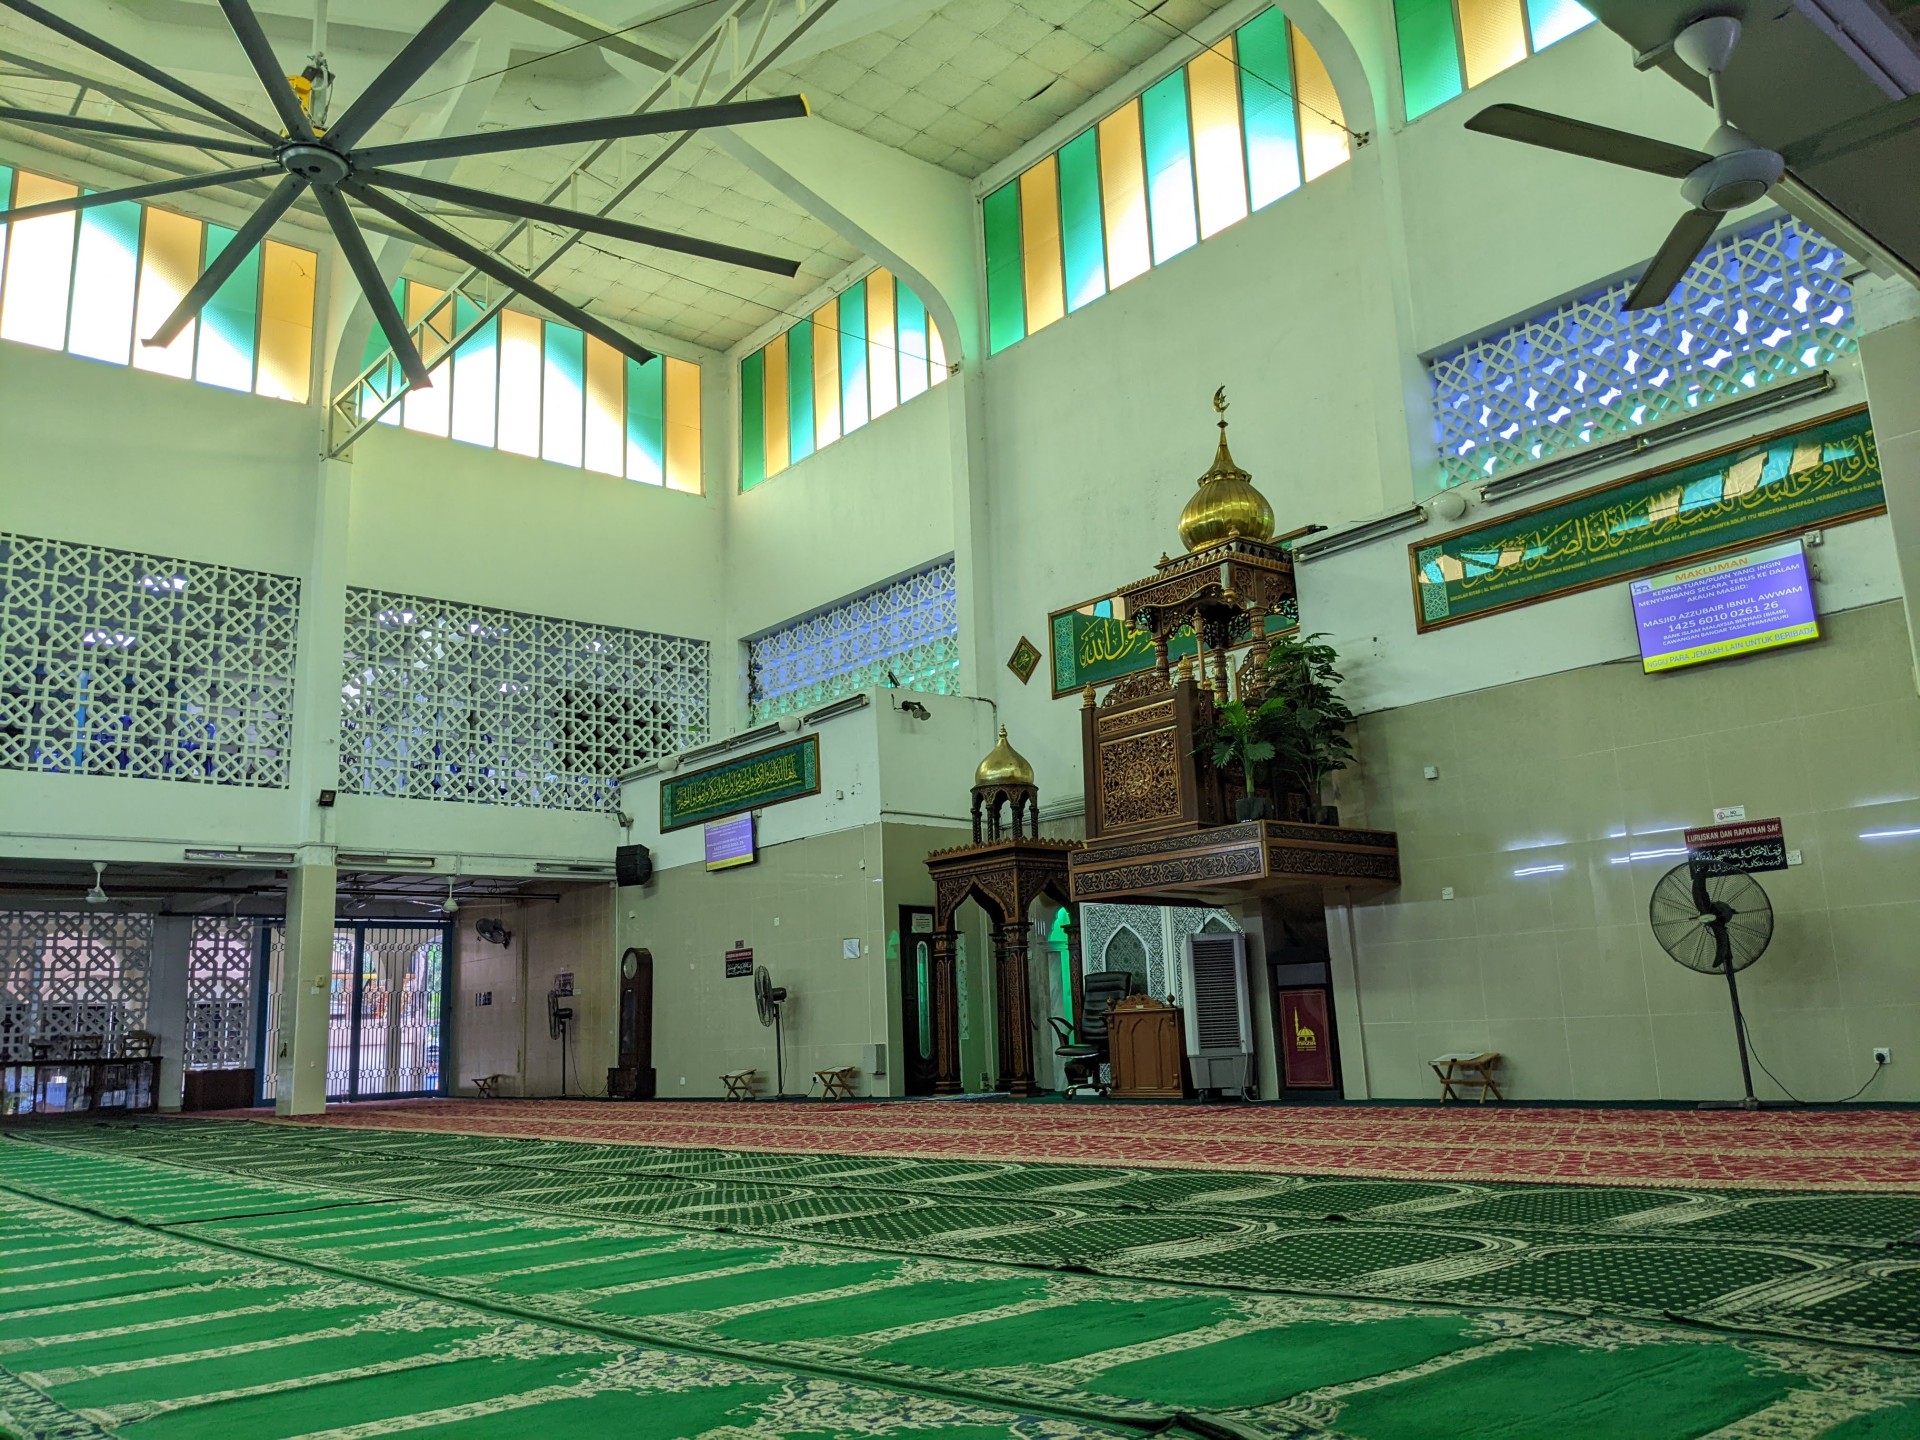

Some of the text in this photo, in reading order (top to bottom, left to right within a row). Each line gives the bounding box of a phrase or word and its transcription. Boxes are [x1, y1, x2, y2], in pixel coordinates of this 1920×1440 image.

[1638, 563, 1800, 608] MENYUMBANG SECARA TERUS KE DALAM
[1652, 561, 1781, 597] KEPADA TUAN/PUAN YANG INGIN
[1675, 557, 1748, 582] MAKLUMAN
[1643, 586, 1803, 628] MASJID AZZUBAIR IBNUL AWWAM
[1687, 584, 1749, 603] AKAUN MASJID:
[1662, 614, 1789, 647] CAWANGAN BANDAR TASIK PERMAISURI
[1663, 608, 1786, 641] BANK ISLAM MALAYSIA BERHAD (BIMB)
[1668, 600, 1779, 633] 1425 6010 0261 26
[1669, 653, 1690, 663] PARA
[1692, 645, 1724, 659] JEMAAH
[1725, 642, 1743, 652] LAIN
[1745, 635, 1773, 648] UNTUK
[1686, 823, 1779, 843] LURUSKAN DAN RAPATKAN SAF
